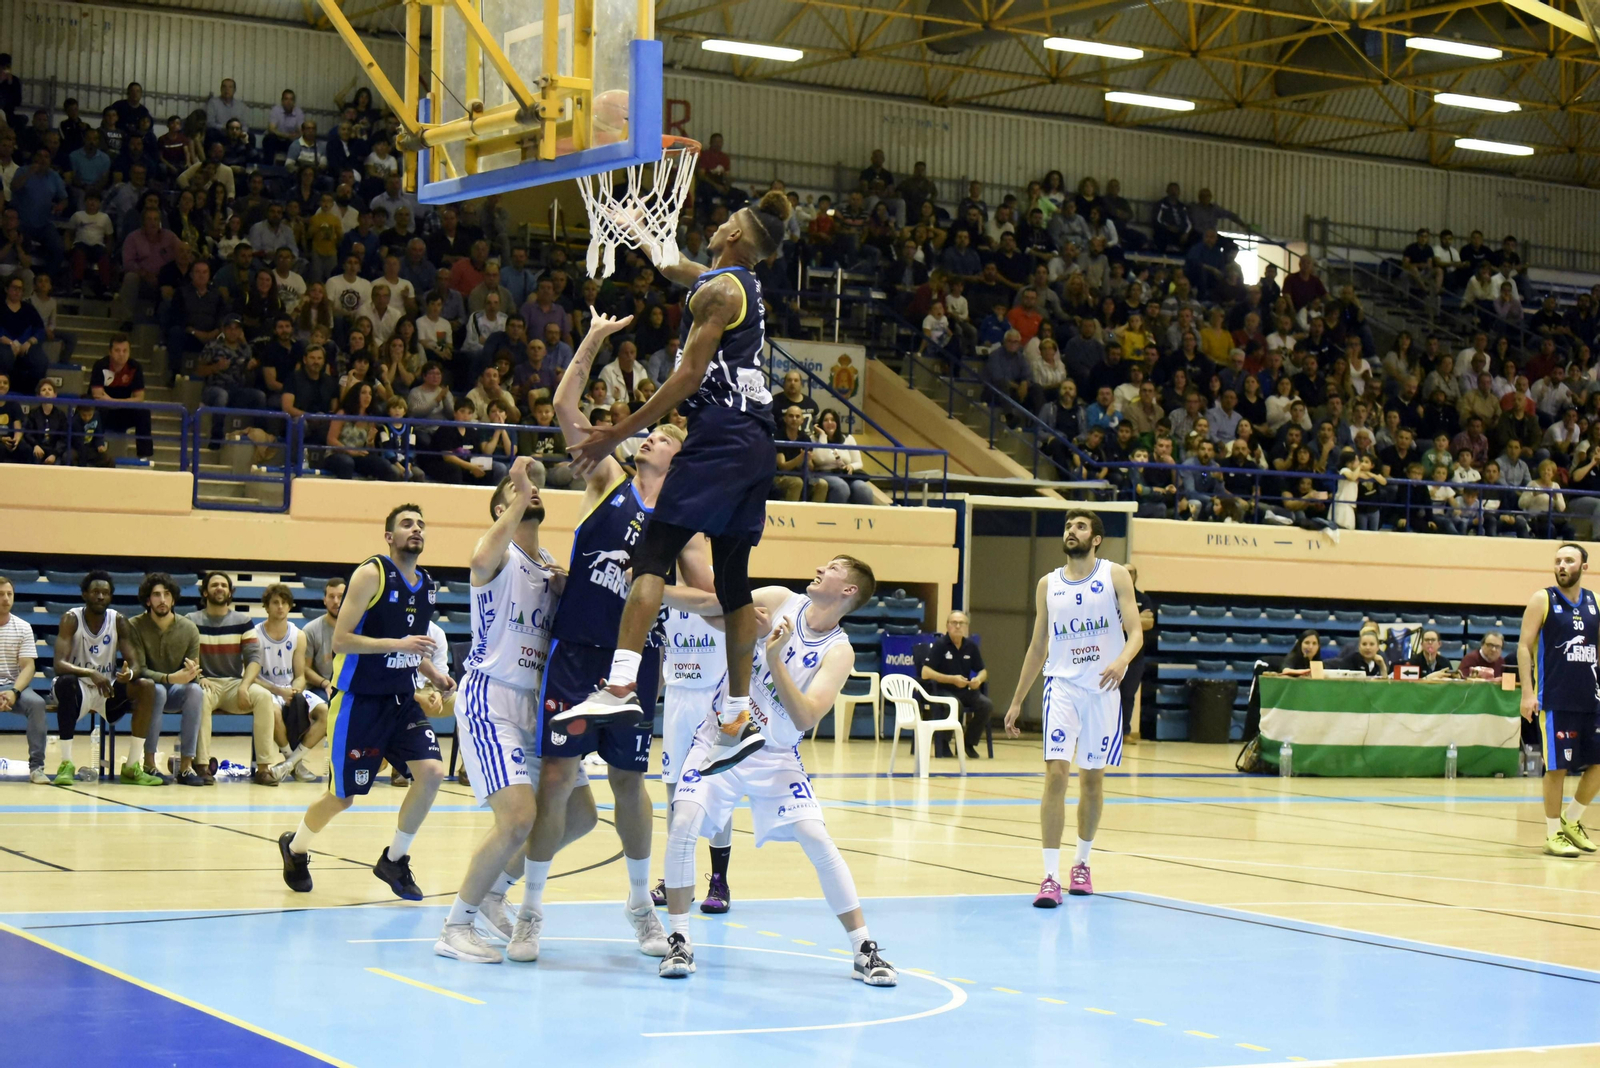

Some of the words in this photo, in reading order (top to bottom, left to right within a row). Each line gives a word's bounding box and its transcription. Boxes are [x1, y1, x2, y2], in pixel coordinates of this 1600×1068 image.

[854, 517, 877, 530] TV
[623, 525, 640, 546] 15
[1206, 533, 1258, 547] PRENSA
[1306, 539, 1323, 550] TV
[542, 577, 549, 594] 7
[1075, 592, 1083, 606] 9
[406, 613, 415, 628] 9
[1572, 620, 1585, 631] 30
[88, 644, 99, 654] 45
[277, 648, 283, 658] 4
[1070, 645, 1101, 656] TOYOTA
[1072, 654, 1101, 665] CUMACA
[673, 663, 702, 671] TOYOTA
[748, 697, 769, 726] OYOTA
[424, 728, 436, 744] 9
[1100, 735, 1110, 753] 9
[788, 781, 813, 800] 21
